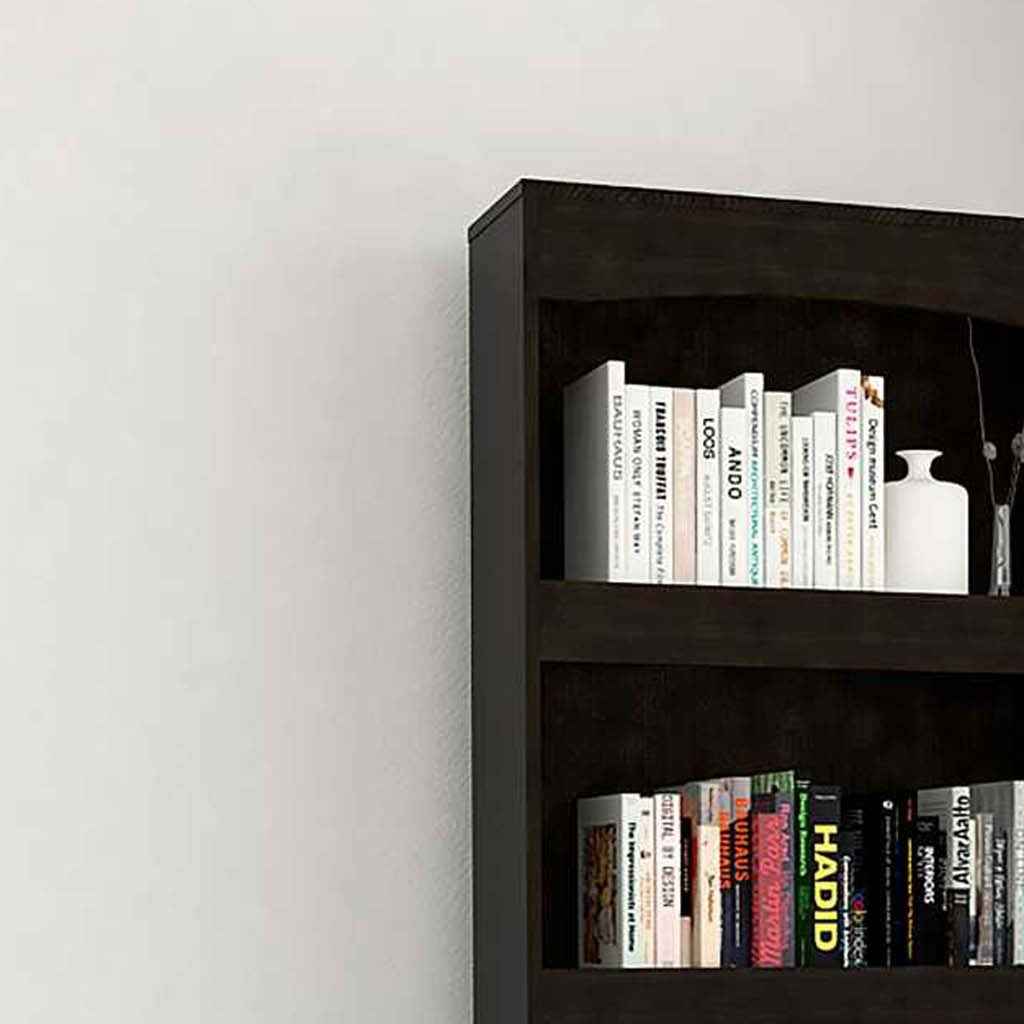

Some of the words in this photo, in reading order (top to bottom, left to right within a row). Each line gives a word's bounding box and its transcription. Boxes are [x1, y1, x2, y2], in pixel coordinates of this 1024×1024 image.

[703, 418, 716, 460] LOOS
[845, 386, 858, 462] TULIPS
[866, 418, 879, 456] Design
[728, 446, 742, 501] ANDO
[868, 457, 878, 502] museum
[627, 821, 637, 838] The
[798, 793, 808, 828] Design
[735, 797, 751, 881] BAUHAUS
[661, 866, 674, 908] DESIGN
[813, 823, 839, 952] HADID
